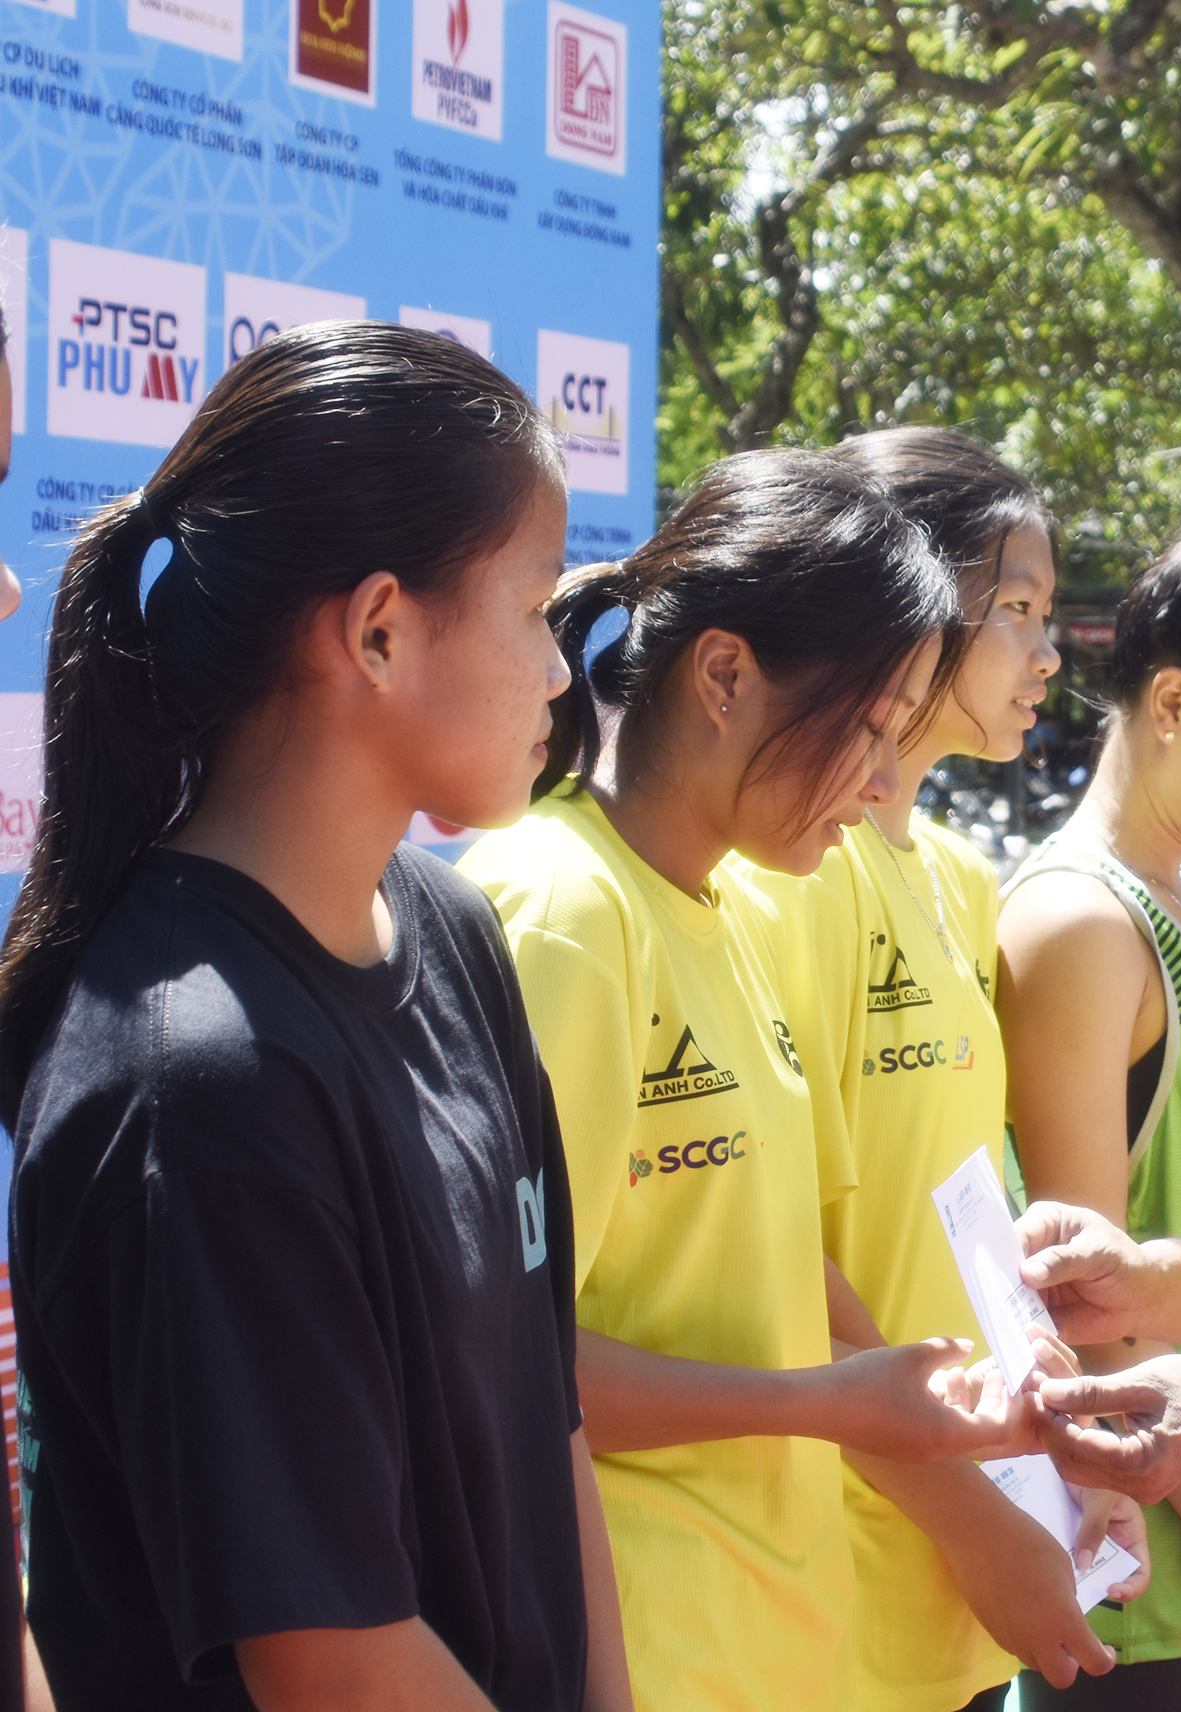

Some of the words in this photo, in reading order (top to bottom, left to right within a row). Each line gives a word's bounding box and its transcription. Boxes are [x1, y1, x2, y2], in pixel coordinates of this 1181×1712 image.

[132, 77, 168, 106] CÔNG
[172, 88, 186, 111] TY
[423, 58, 492, 102] PETROVIETNAM
[68, 90, 102, 117] NAM
[201, 130, 234, 153] LONG
[79, 296, 177, 350] PTSC
[58, 337, 132, 396] PHU
[562, 372, 607, 415] CCT
[37, 475, 75, 501] CÔNG
[79, 481, 95, 501] TY
[31, 505, 59, 532] DẦU
[874, 992, 900, 1007] ANH
[880, 1039, 947, 1074] SCGC
[652, 1080, 689, 1098] ANH
[693, 1070, 735, 1090] Co.LTD
[657, 1130, 747, 1174] SCGC
